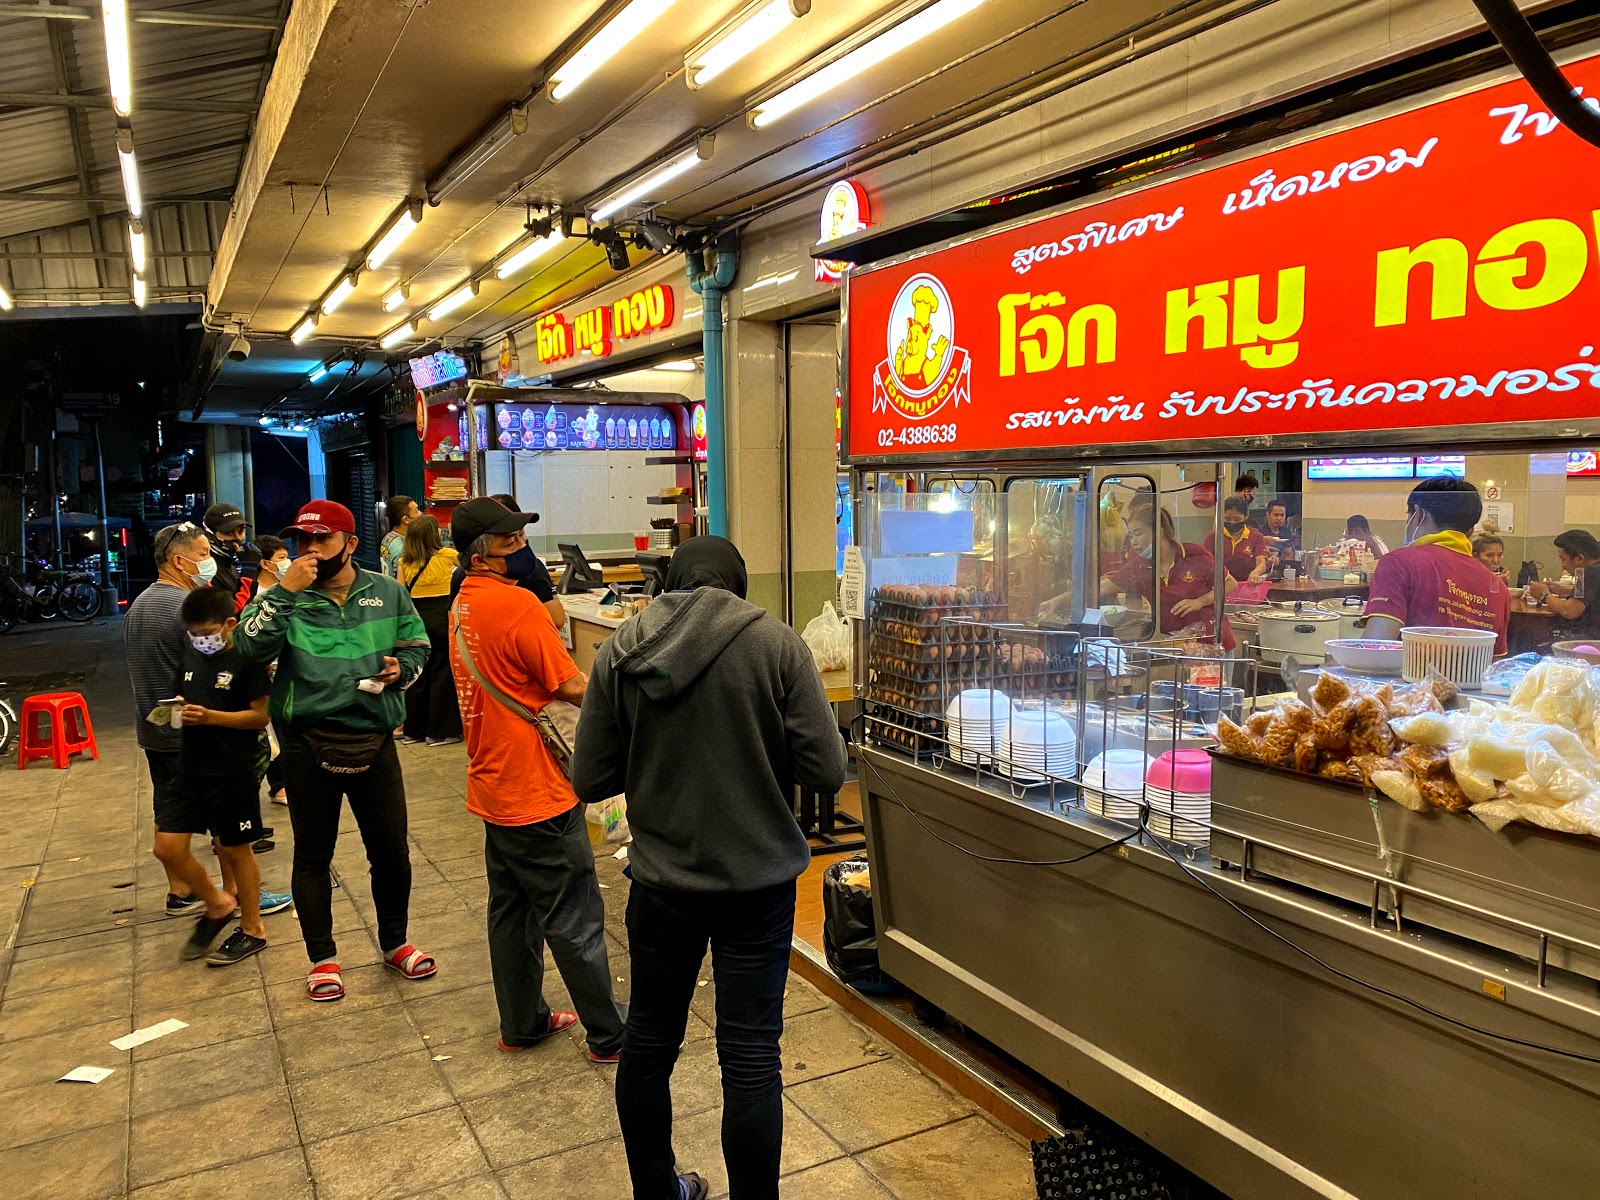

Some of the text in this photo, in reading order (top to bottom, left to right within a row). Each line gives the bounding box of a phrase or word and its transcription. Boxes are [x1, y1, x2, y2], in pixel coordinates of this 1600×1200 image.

[1011, 206, 1184, 275] สูตรพิเศษ
[1222, 137, 1439, 214] เห็ดหอม
[535, 284, 666, 363] โจ๊ก หมู ทอง
[997, 208, 1600, 378] โจ๊ก หมู ทอ
[884, 367, 957, 416] โจ๊กหมูทอง
[1005, 345, 1600, 430] รสเข้มข้น รับประกันความอร่
[878, 423, 957, 447] 02-4388638
[358, 597, 384, 607] Grab
[321, 761, 370, 774] Supreme
